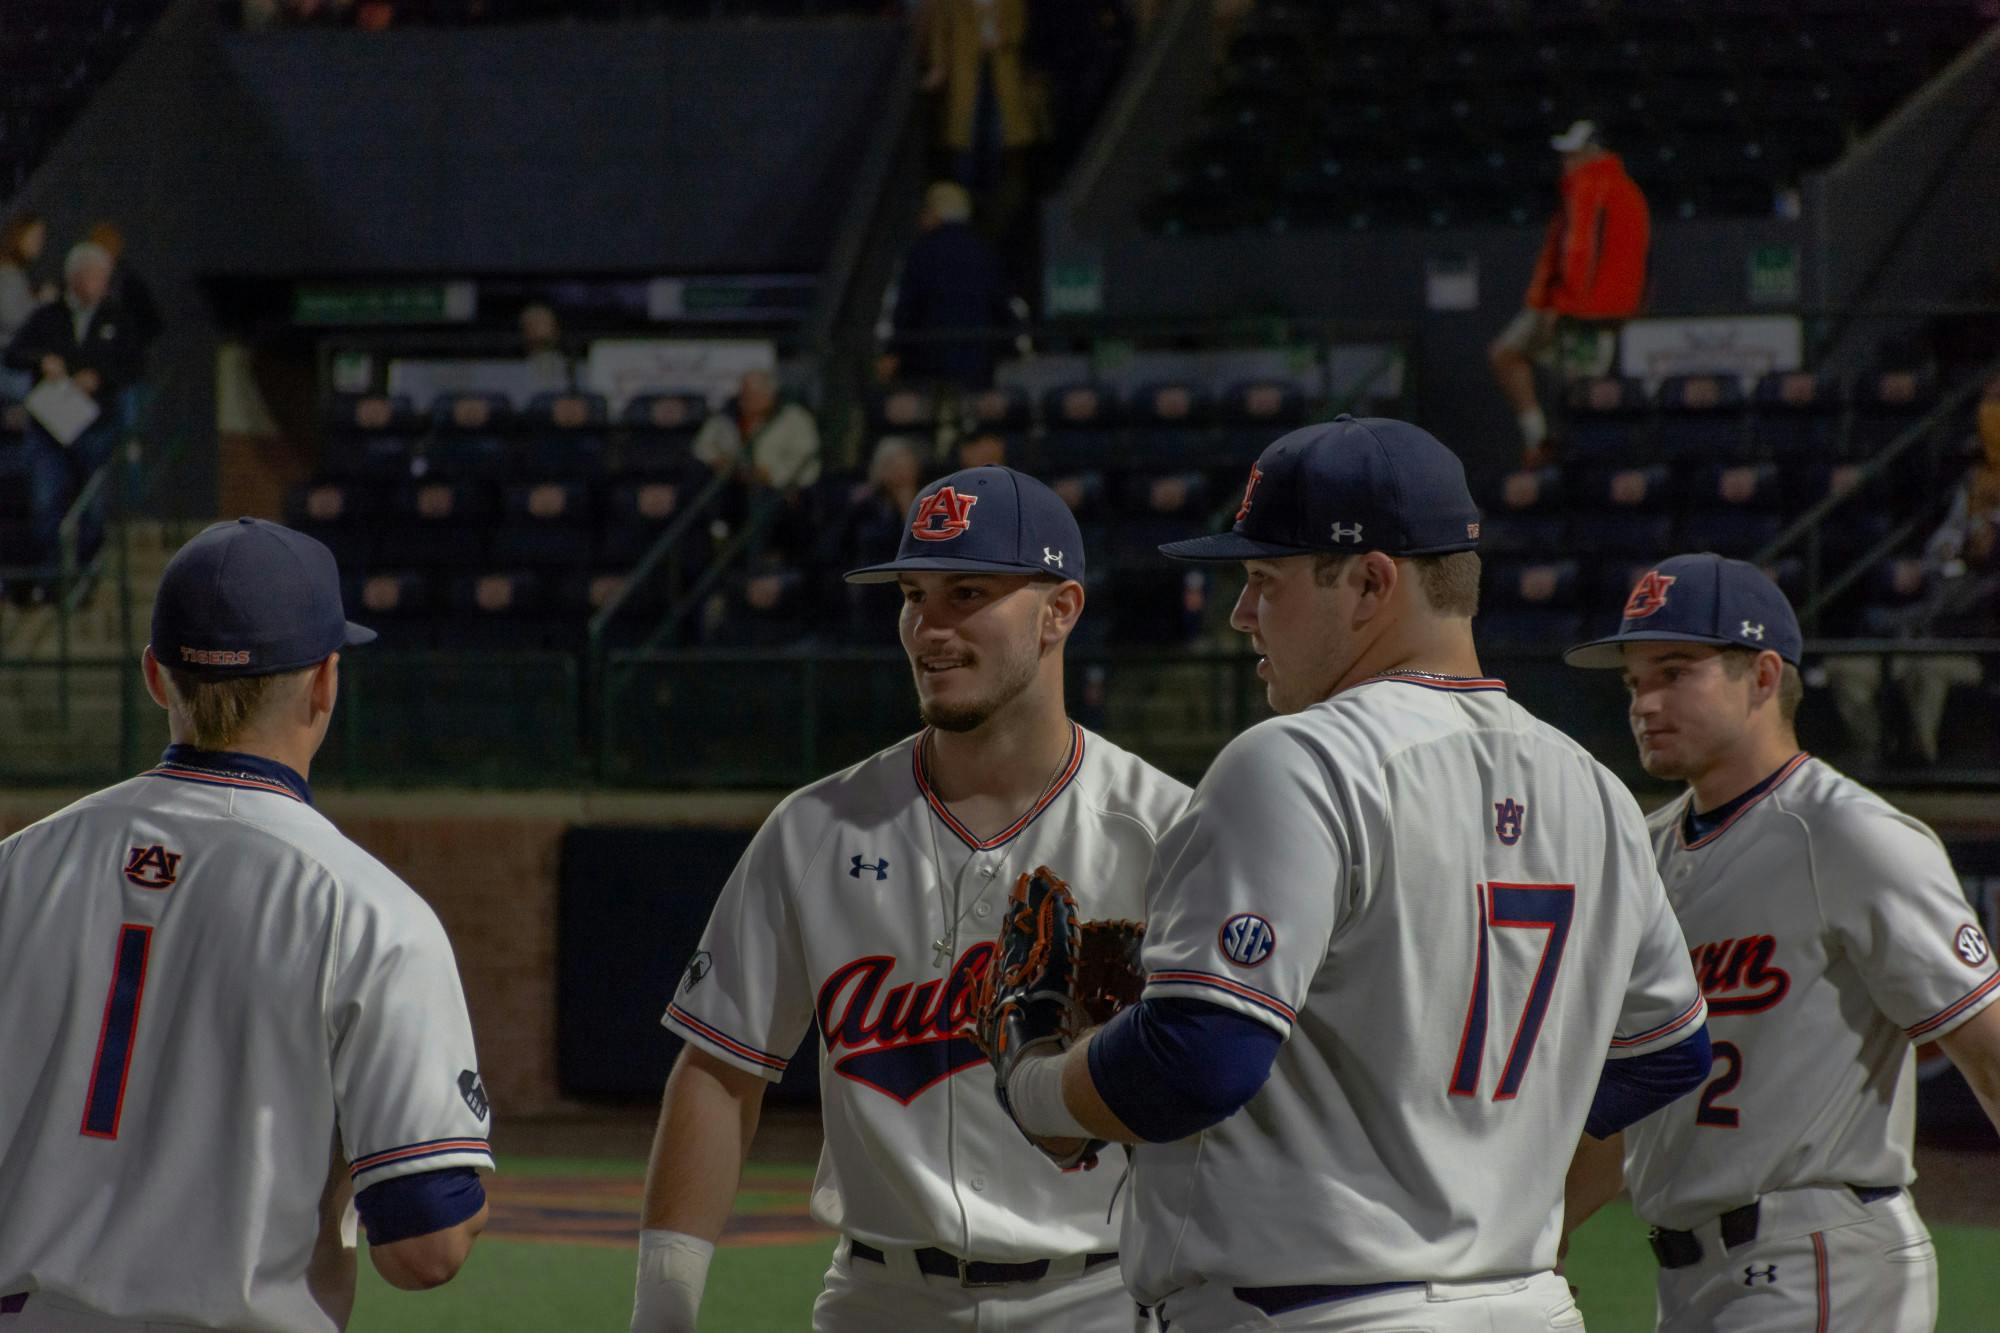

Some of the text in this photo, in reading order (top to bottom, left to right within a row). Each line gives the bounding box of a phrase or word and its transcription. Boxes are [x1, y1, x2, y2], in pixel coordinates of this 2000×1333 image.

[178, 644, 252, 665] TIGERS
[1223, 915, 1273, 965] SEC
[80, 923, 153, 1140] 1
[1448, 881, 1575, 1101] 17
[1697, 1041, 1742, 1128] 2
